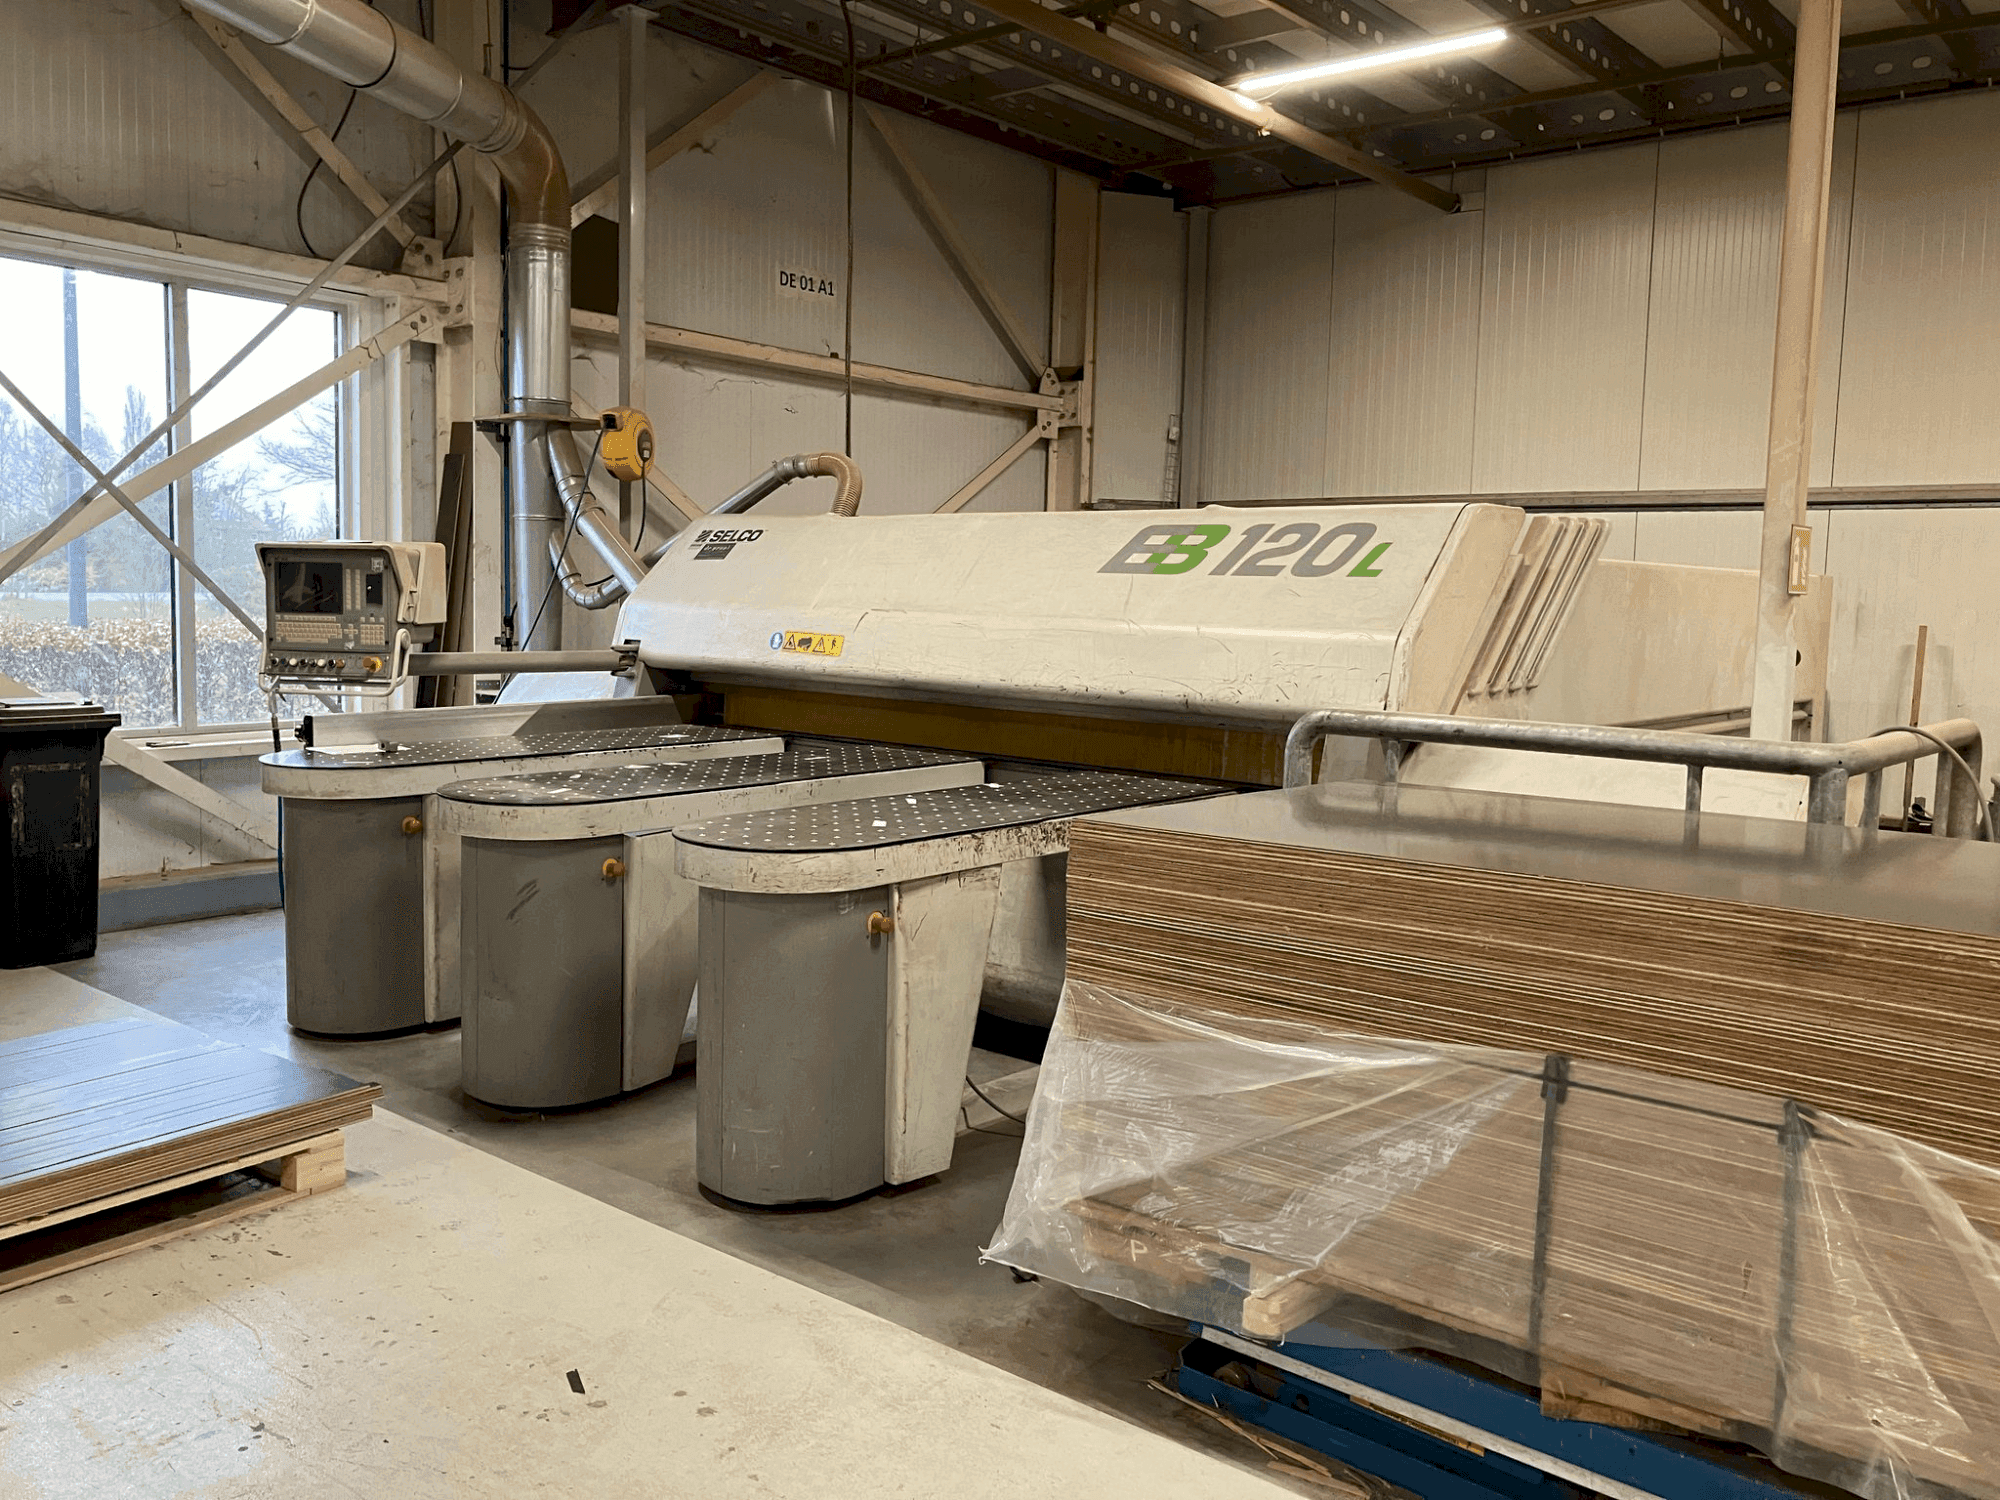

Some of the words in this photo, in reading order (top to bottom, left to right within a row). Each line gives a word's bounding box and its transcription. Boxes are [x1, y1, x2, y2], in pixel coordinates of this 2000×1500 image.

[779, 270, 797, 289] DE
[799, 275, 815, 292] 01
[817, 279, 835, 297] A1
[708, 529, 764, 542] SELCO
